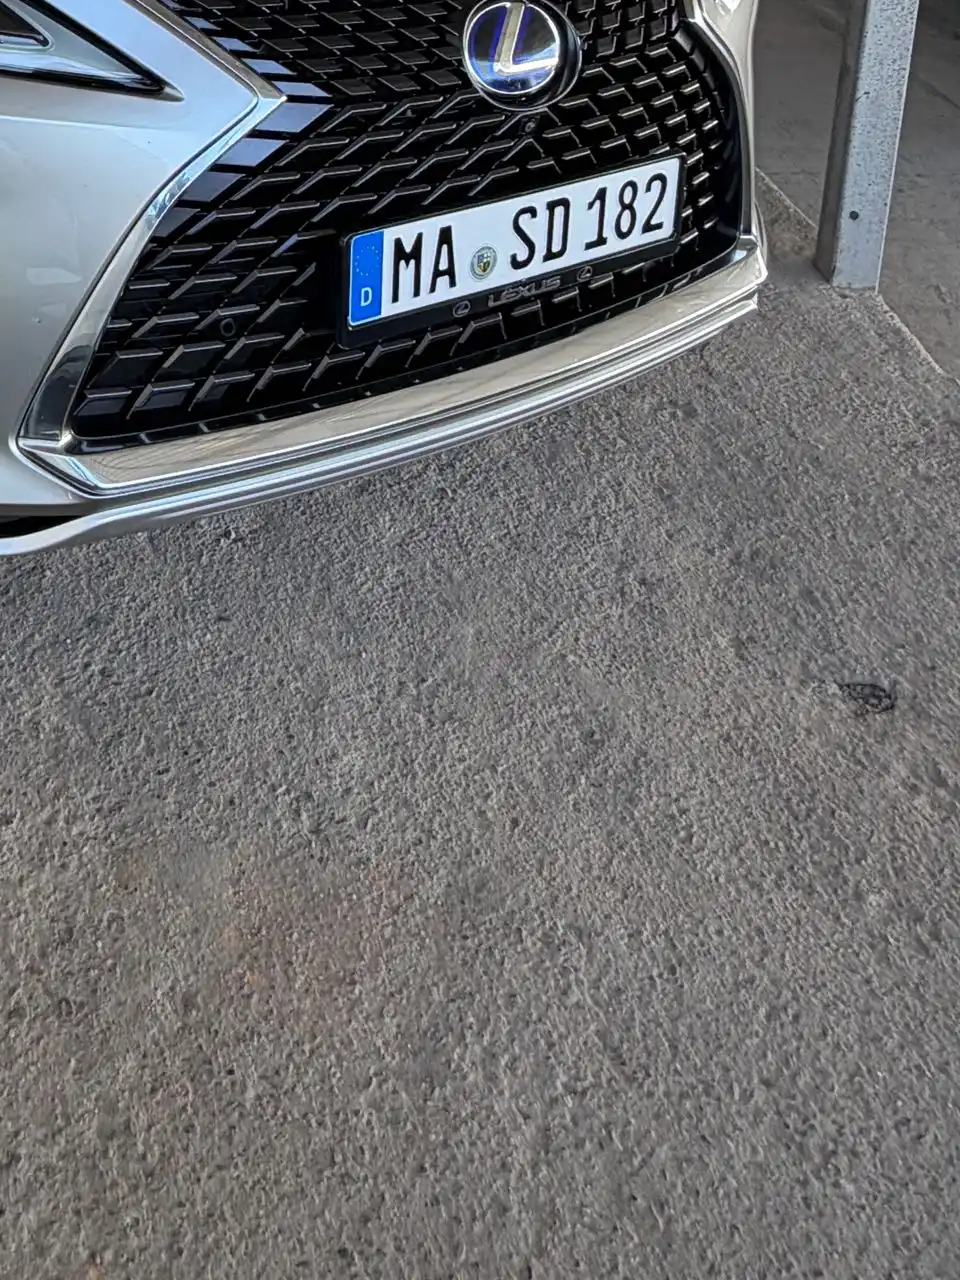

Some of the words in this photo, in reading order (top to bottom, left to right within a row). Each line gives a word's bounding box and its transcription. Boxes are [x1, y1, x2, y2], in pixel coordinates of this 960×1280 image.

[391, 225, 458, 304] MA
[510, 196, 571, 270] SD
[584, 172, 668, 251] 182
[360, 286, 373, 307] D
[488, 276, 561, 307] LEXUS
